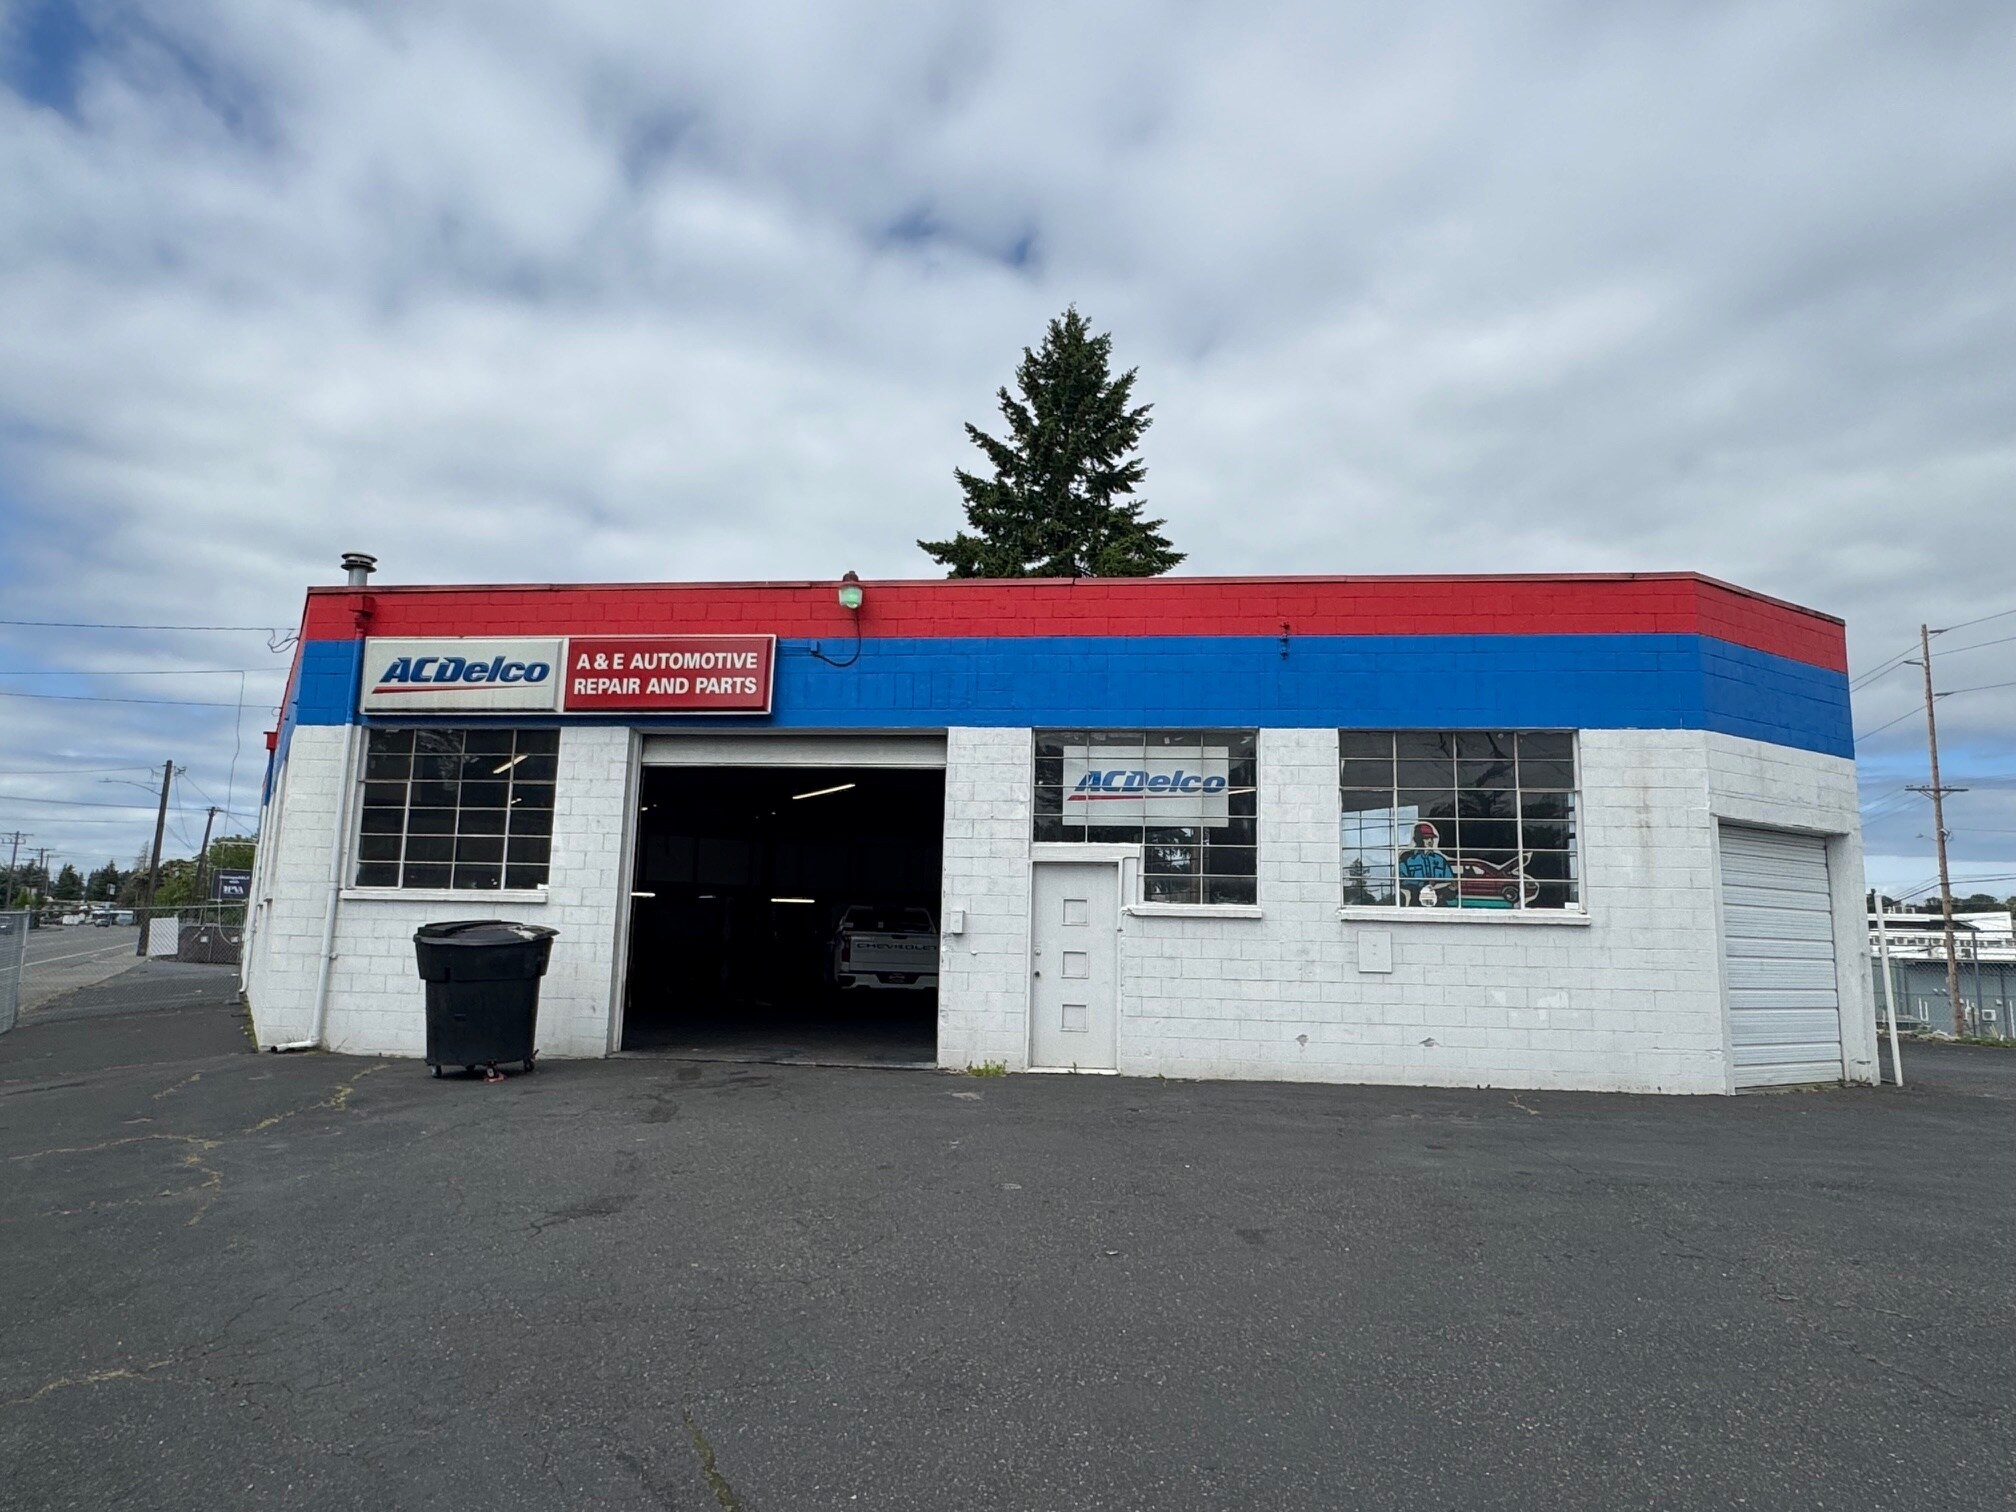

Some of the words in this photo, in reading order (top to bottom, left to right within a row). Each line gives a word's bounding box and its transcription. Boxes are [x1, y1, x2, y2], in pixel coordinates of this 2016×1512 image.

[379, 656, 551, 683] ACDelco
[576, 654, 591, 670] A
[594, 653, 609, 670] &
[613, 654, 625, 670] E
[630, 653, 758, 670] AUTOMOTIVE
[573, 678, 641, 695] REPAIR
[646, 678, 690, 694] AND
[695, 677, 758, 694] PARTS
[1074, 770, 1226, 793] ACDelco
[856, 943, 938, 951] CHEVROLET
